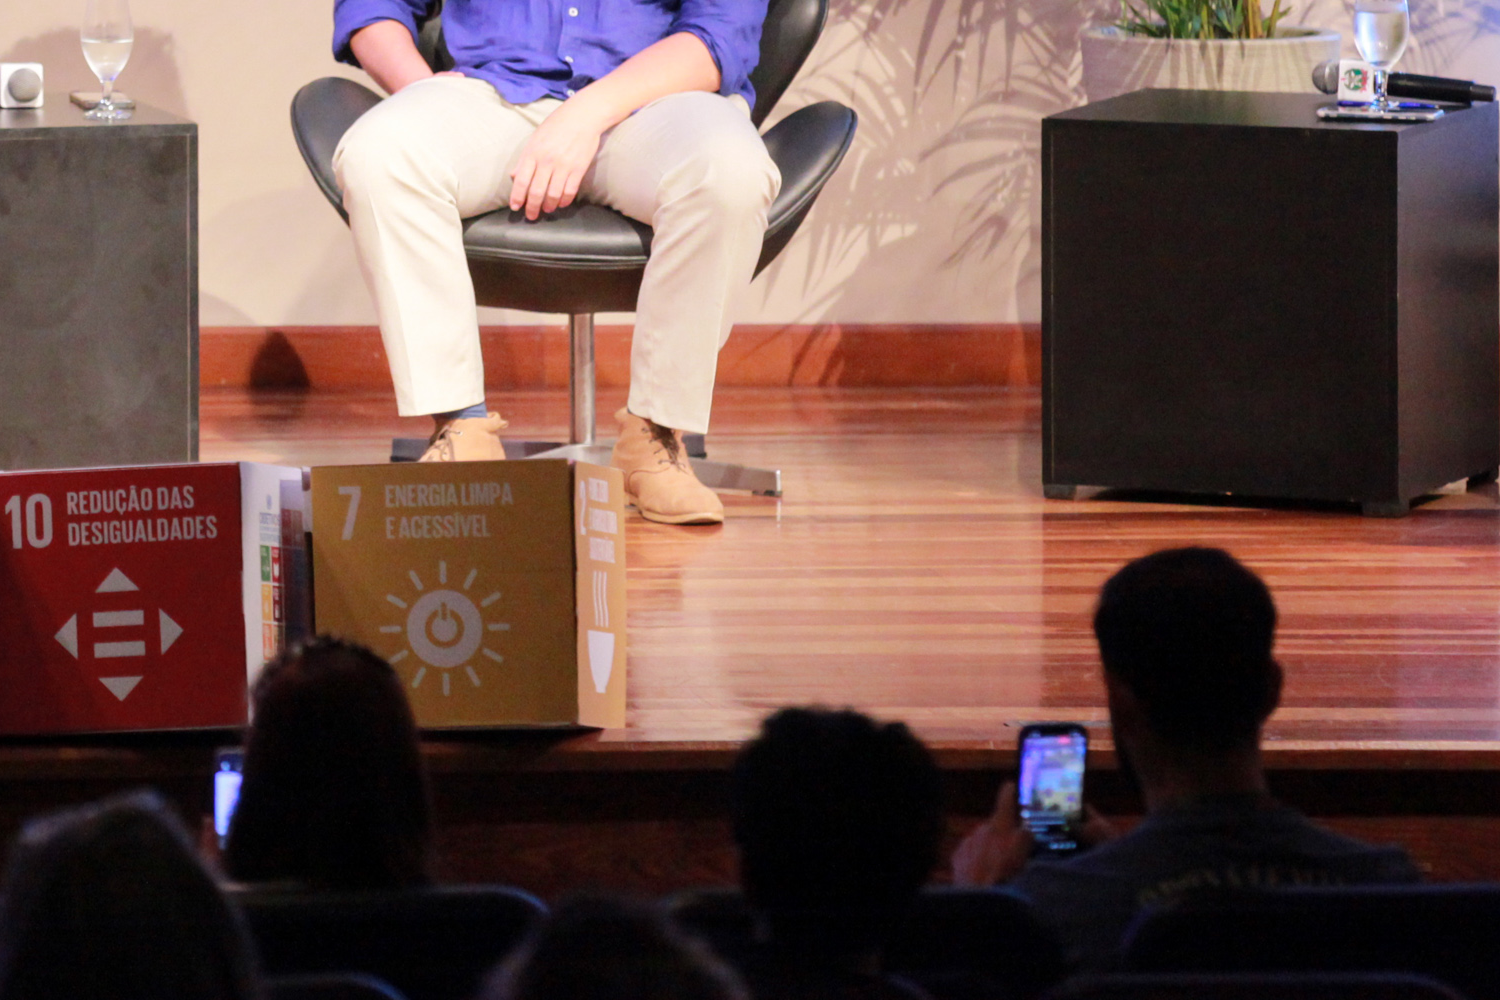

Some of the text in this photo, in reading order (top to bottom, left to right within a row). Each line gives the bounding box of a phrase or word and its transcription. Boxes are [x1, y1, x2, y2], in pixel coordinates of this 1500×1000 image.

[66, 485, 195, 517] REDUÇÃO DAS
[385, 482, 514, 508] ENERGIA LIMPA
[4, 493, 53, 549] 10
[338, 486, 361, 541] 7
[385, 512, 491, 539] E ACESSÍVEL
[67, 514, 218, 547] DESIGUALDADES
